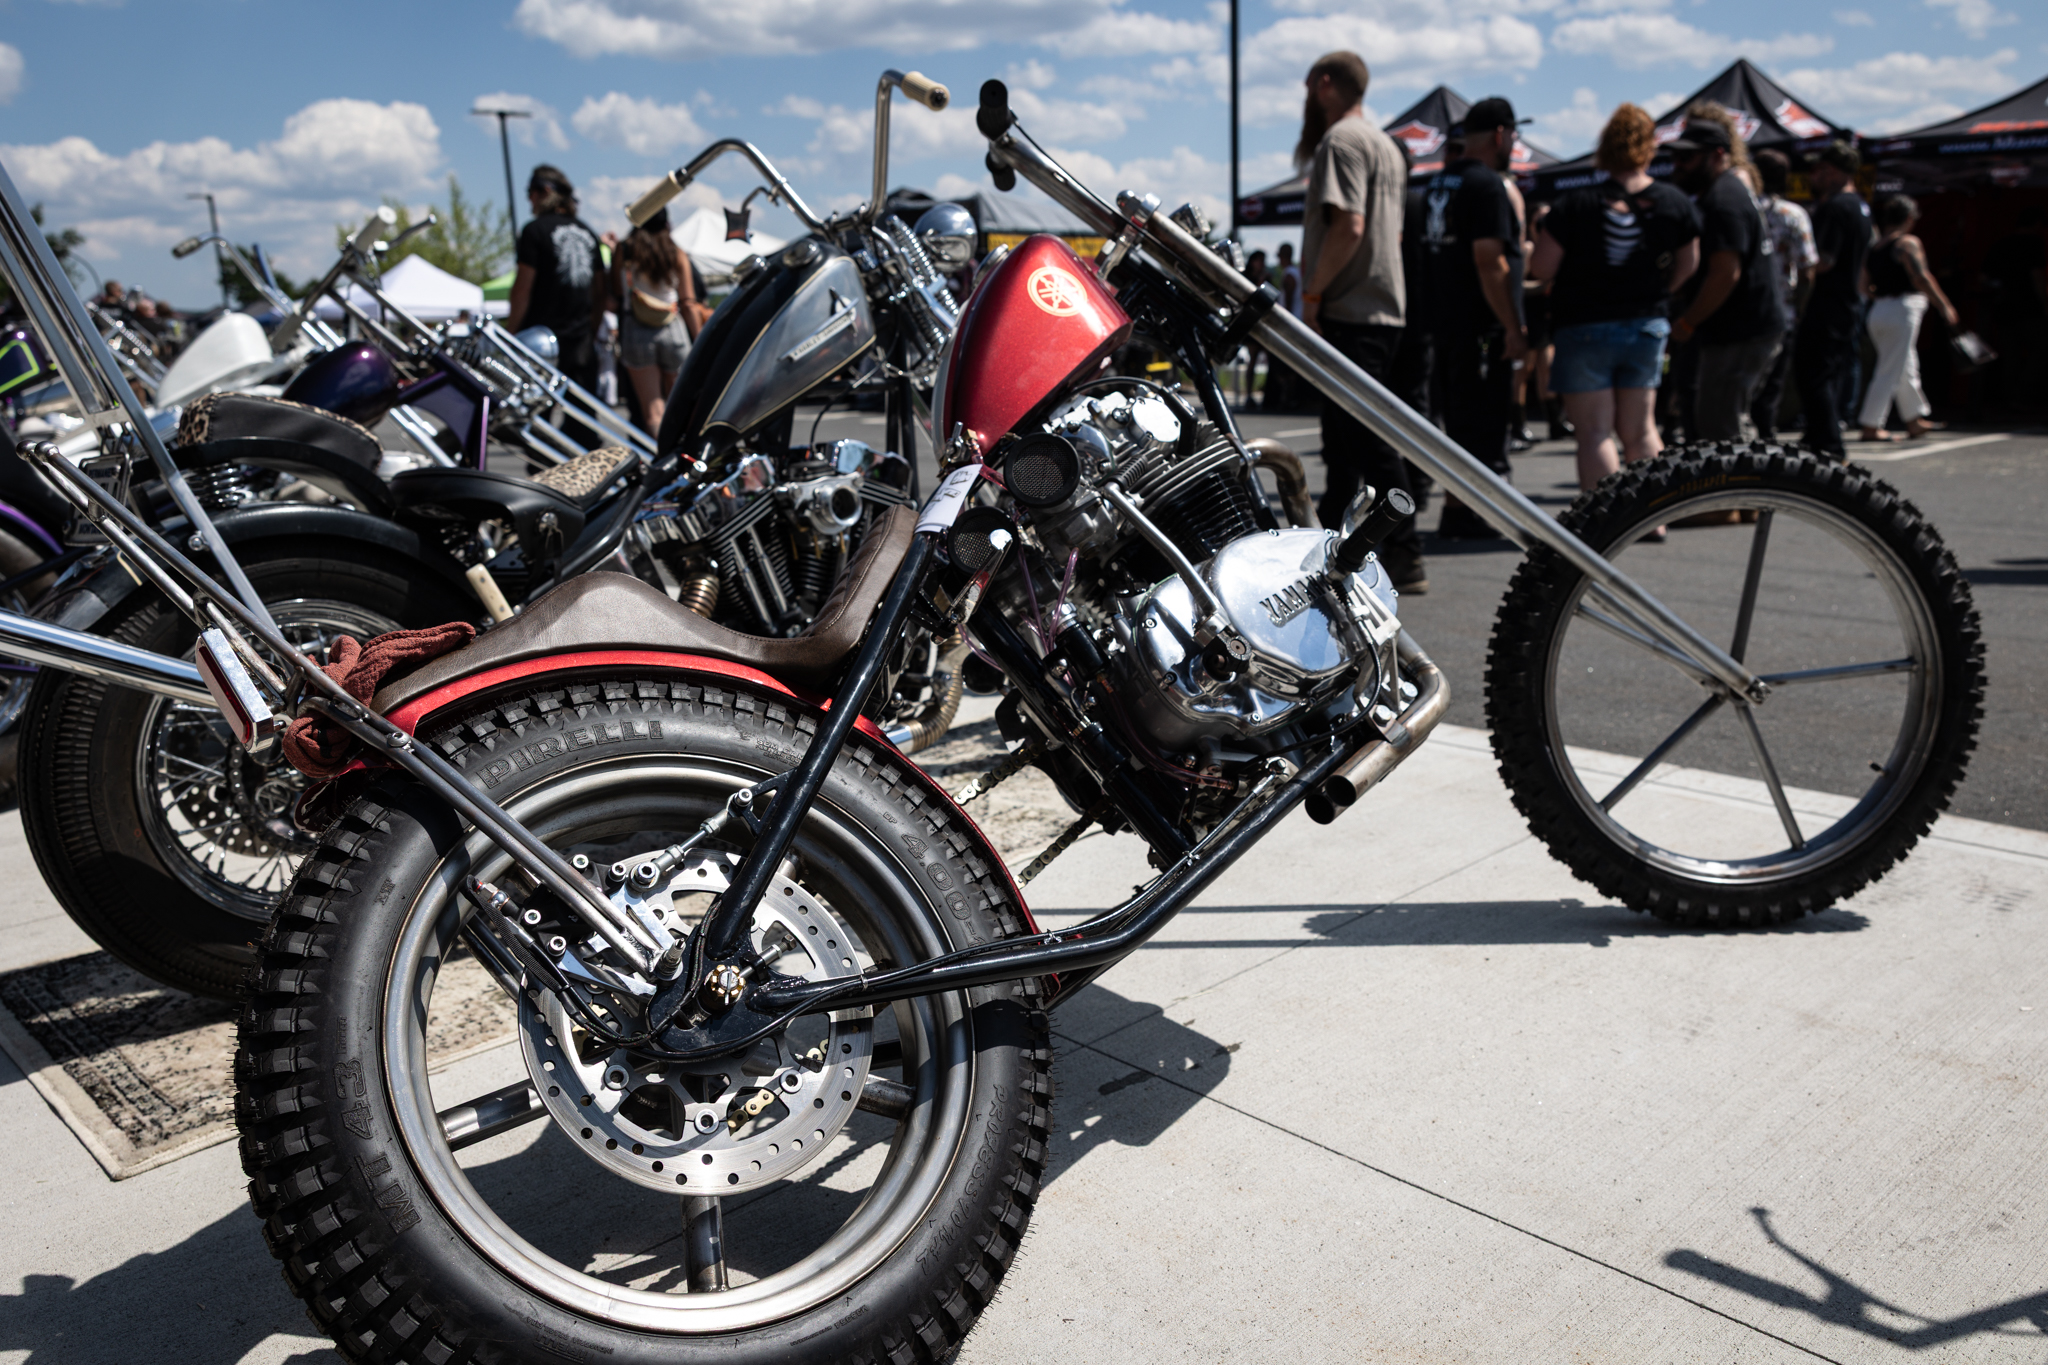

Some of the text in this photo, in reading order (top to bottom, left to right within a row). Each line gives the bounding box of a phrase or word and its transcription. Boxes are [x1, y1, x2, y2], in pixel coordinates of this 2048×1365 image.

[475, 719, 664, 790] PIRELLI
[333, 1058, 423, 1236] MT 43
